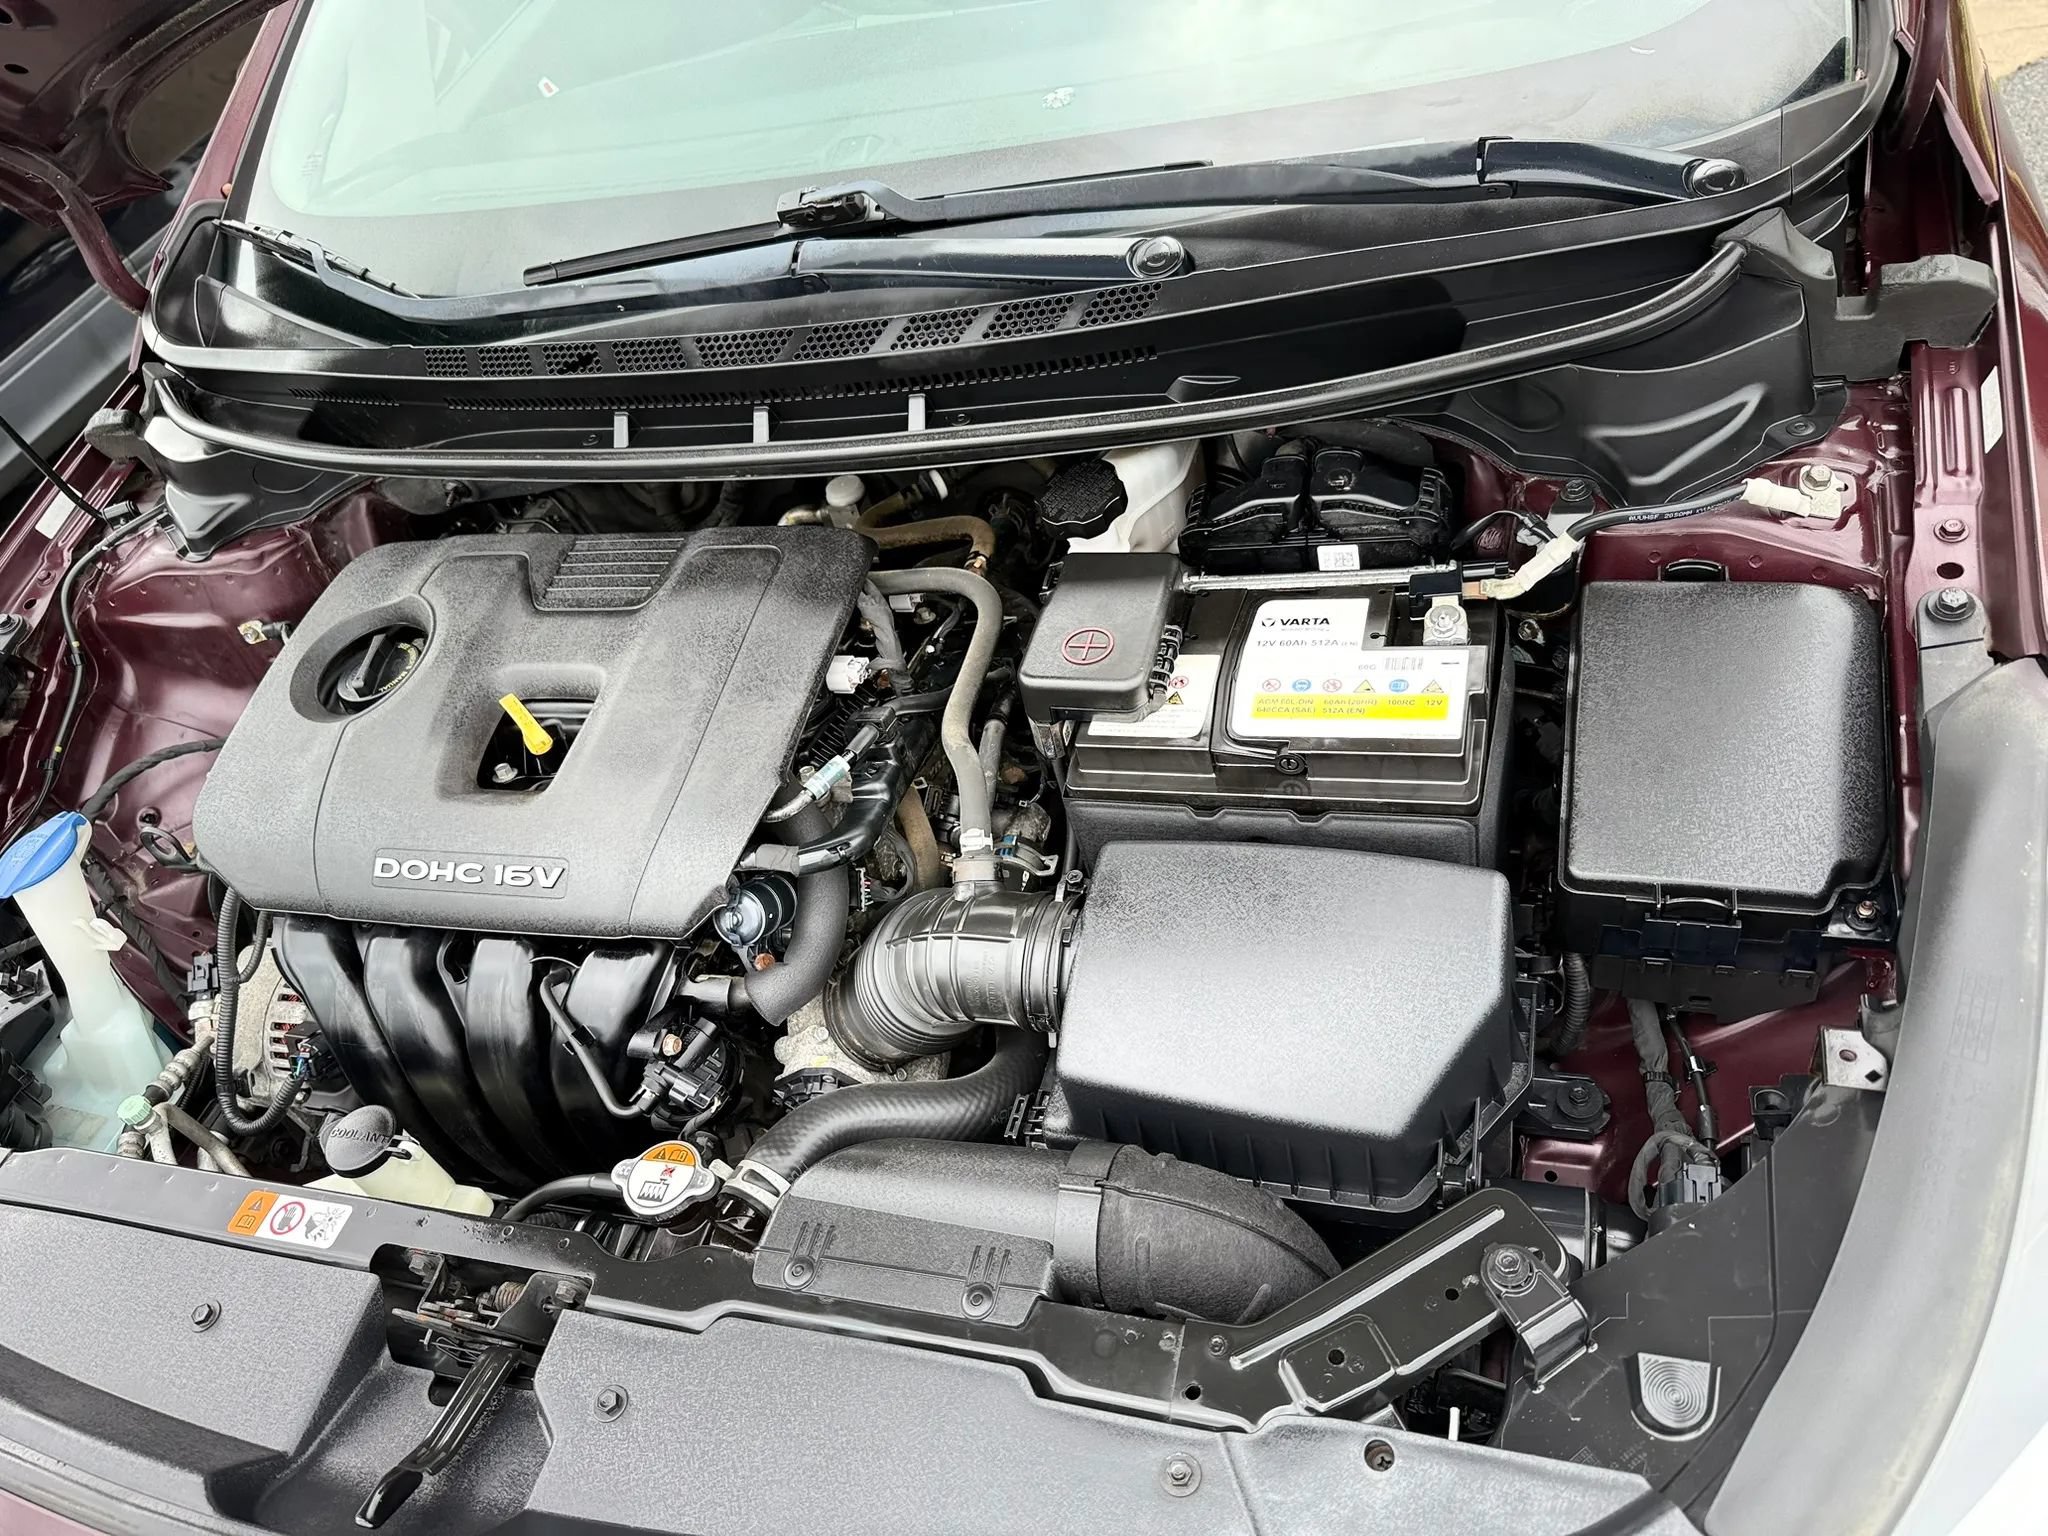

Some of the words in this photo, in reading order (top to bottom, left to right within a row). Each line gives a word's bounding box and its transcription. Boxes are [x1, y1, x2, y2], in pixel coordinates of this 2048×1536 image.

[1280, 617, 1330, 626] VARTA
[1257, 639, 1277, 647] 12V
[1279, 639, 1307, 647] 60Ah
[1311, 639, 1339, 647] 512A
[373, 857, 485, 884] DOHC
[494, 864, 565, 889] 16V
[330, 1127, 390, 1145] COOLANT
